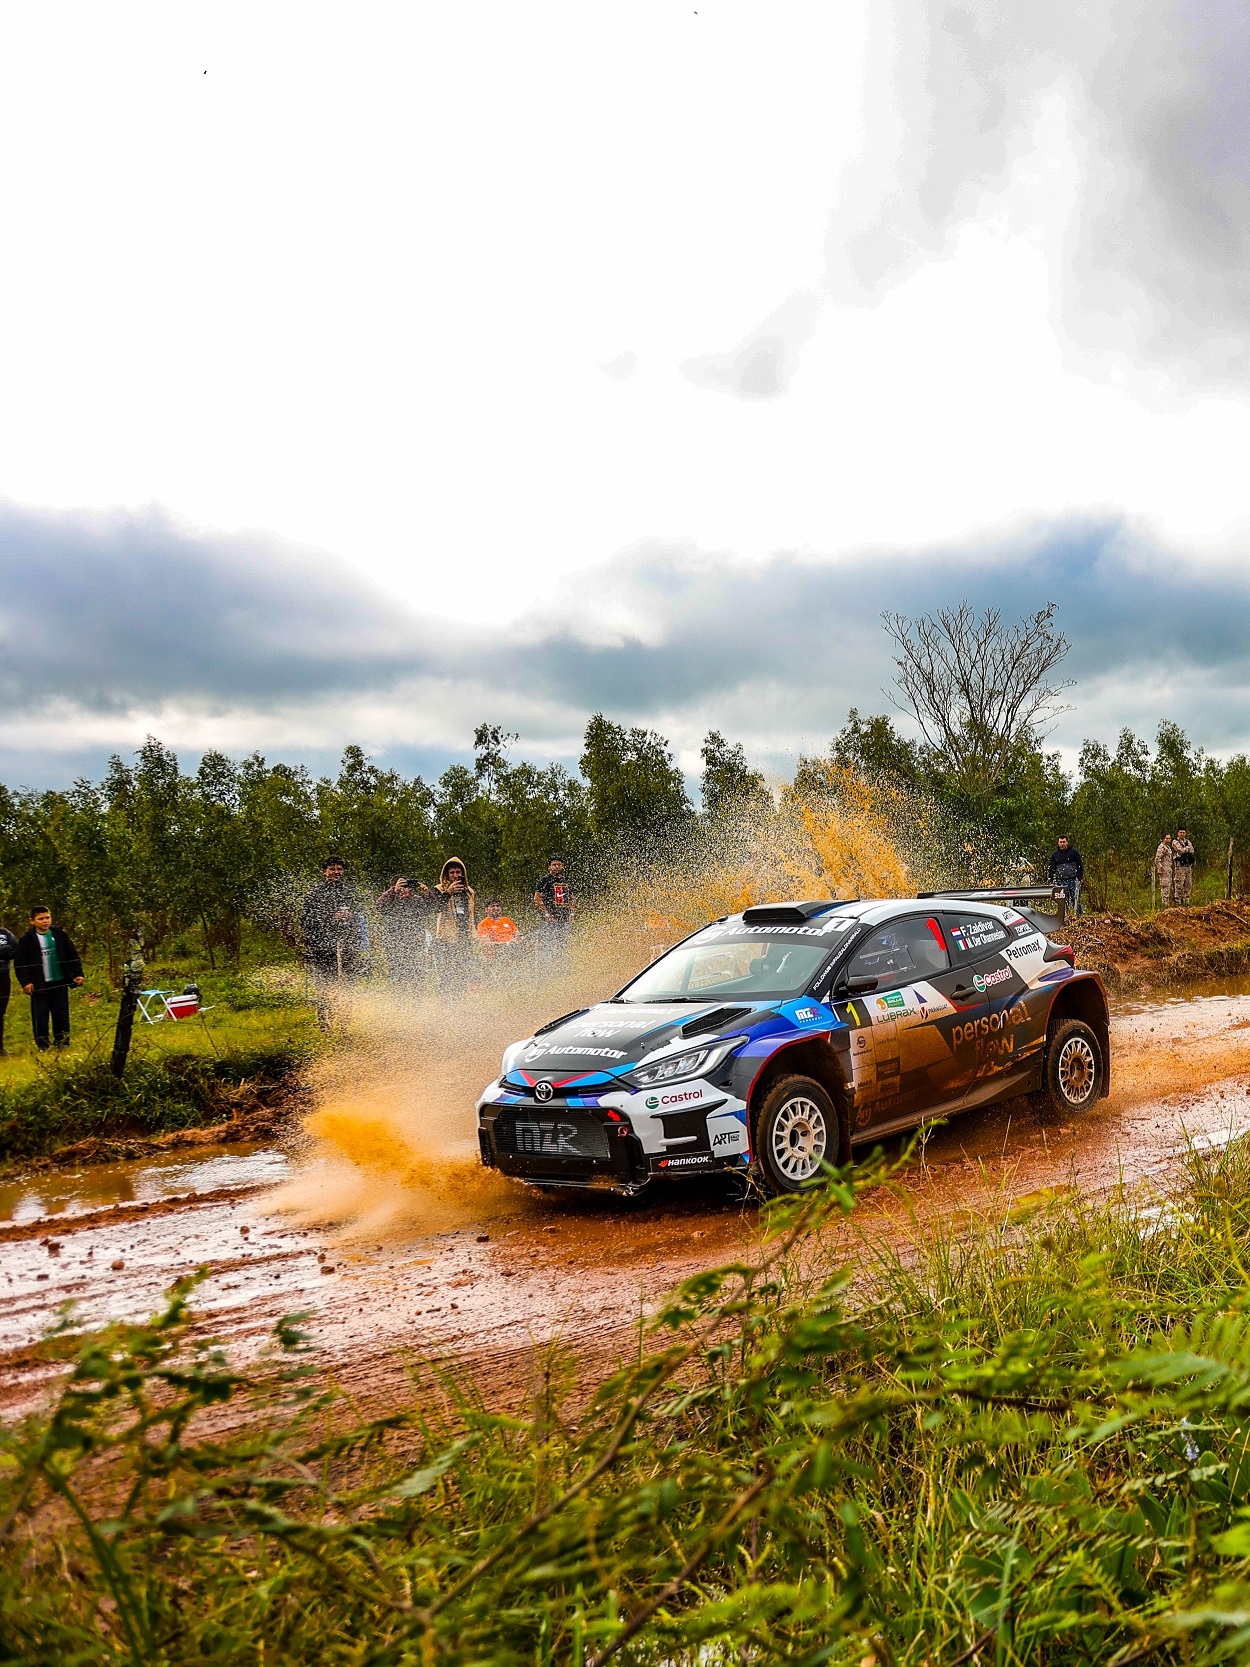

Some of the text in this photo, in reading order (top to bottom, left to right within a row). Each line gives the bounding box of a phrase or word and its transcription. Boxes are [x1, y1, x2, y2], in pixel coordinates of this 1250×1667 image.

[720, 926, 832, 937] Automotor
[833, 919, 847, 929] 1
[926, 918, 947, 951] 1
[983, 965, 1013, 987] Castrol
[846, 1001, 861, 1026] 1
[565, 1020, 656, 1031] personal
[951, 1000, 1032, 1053] personal
[544, 1044, 628, 1060] Automotor
[661, 1089, 703, 1105] Castrol
[667, 1156, 709, 1167] HANKOOK
